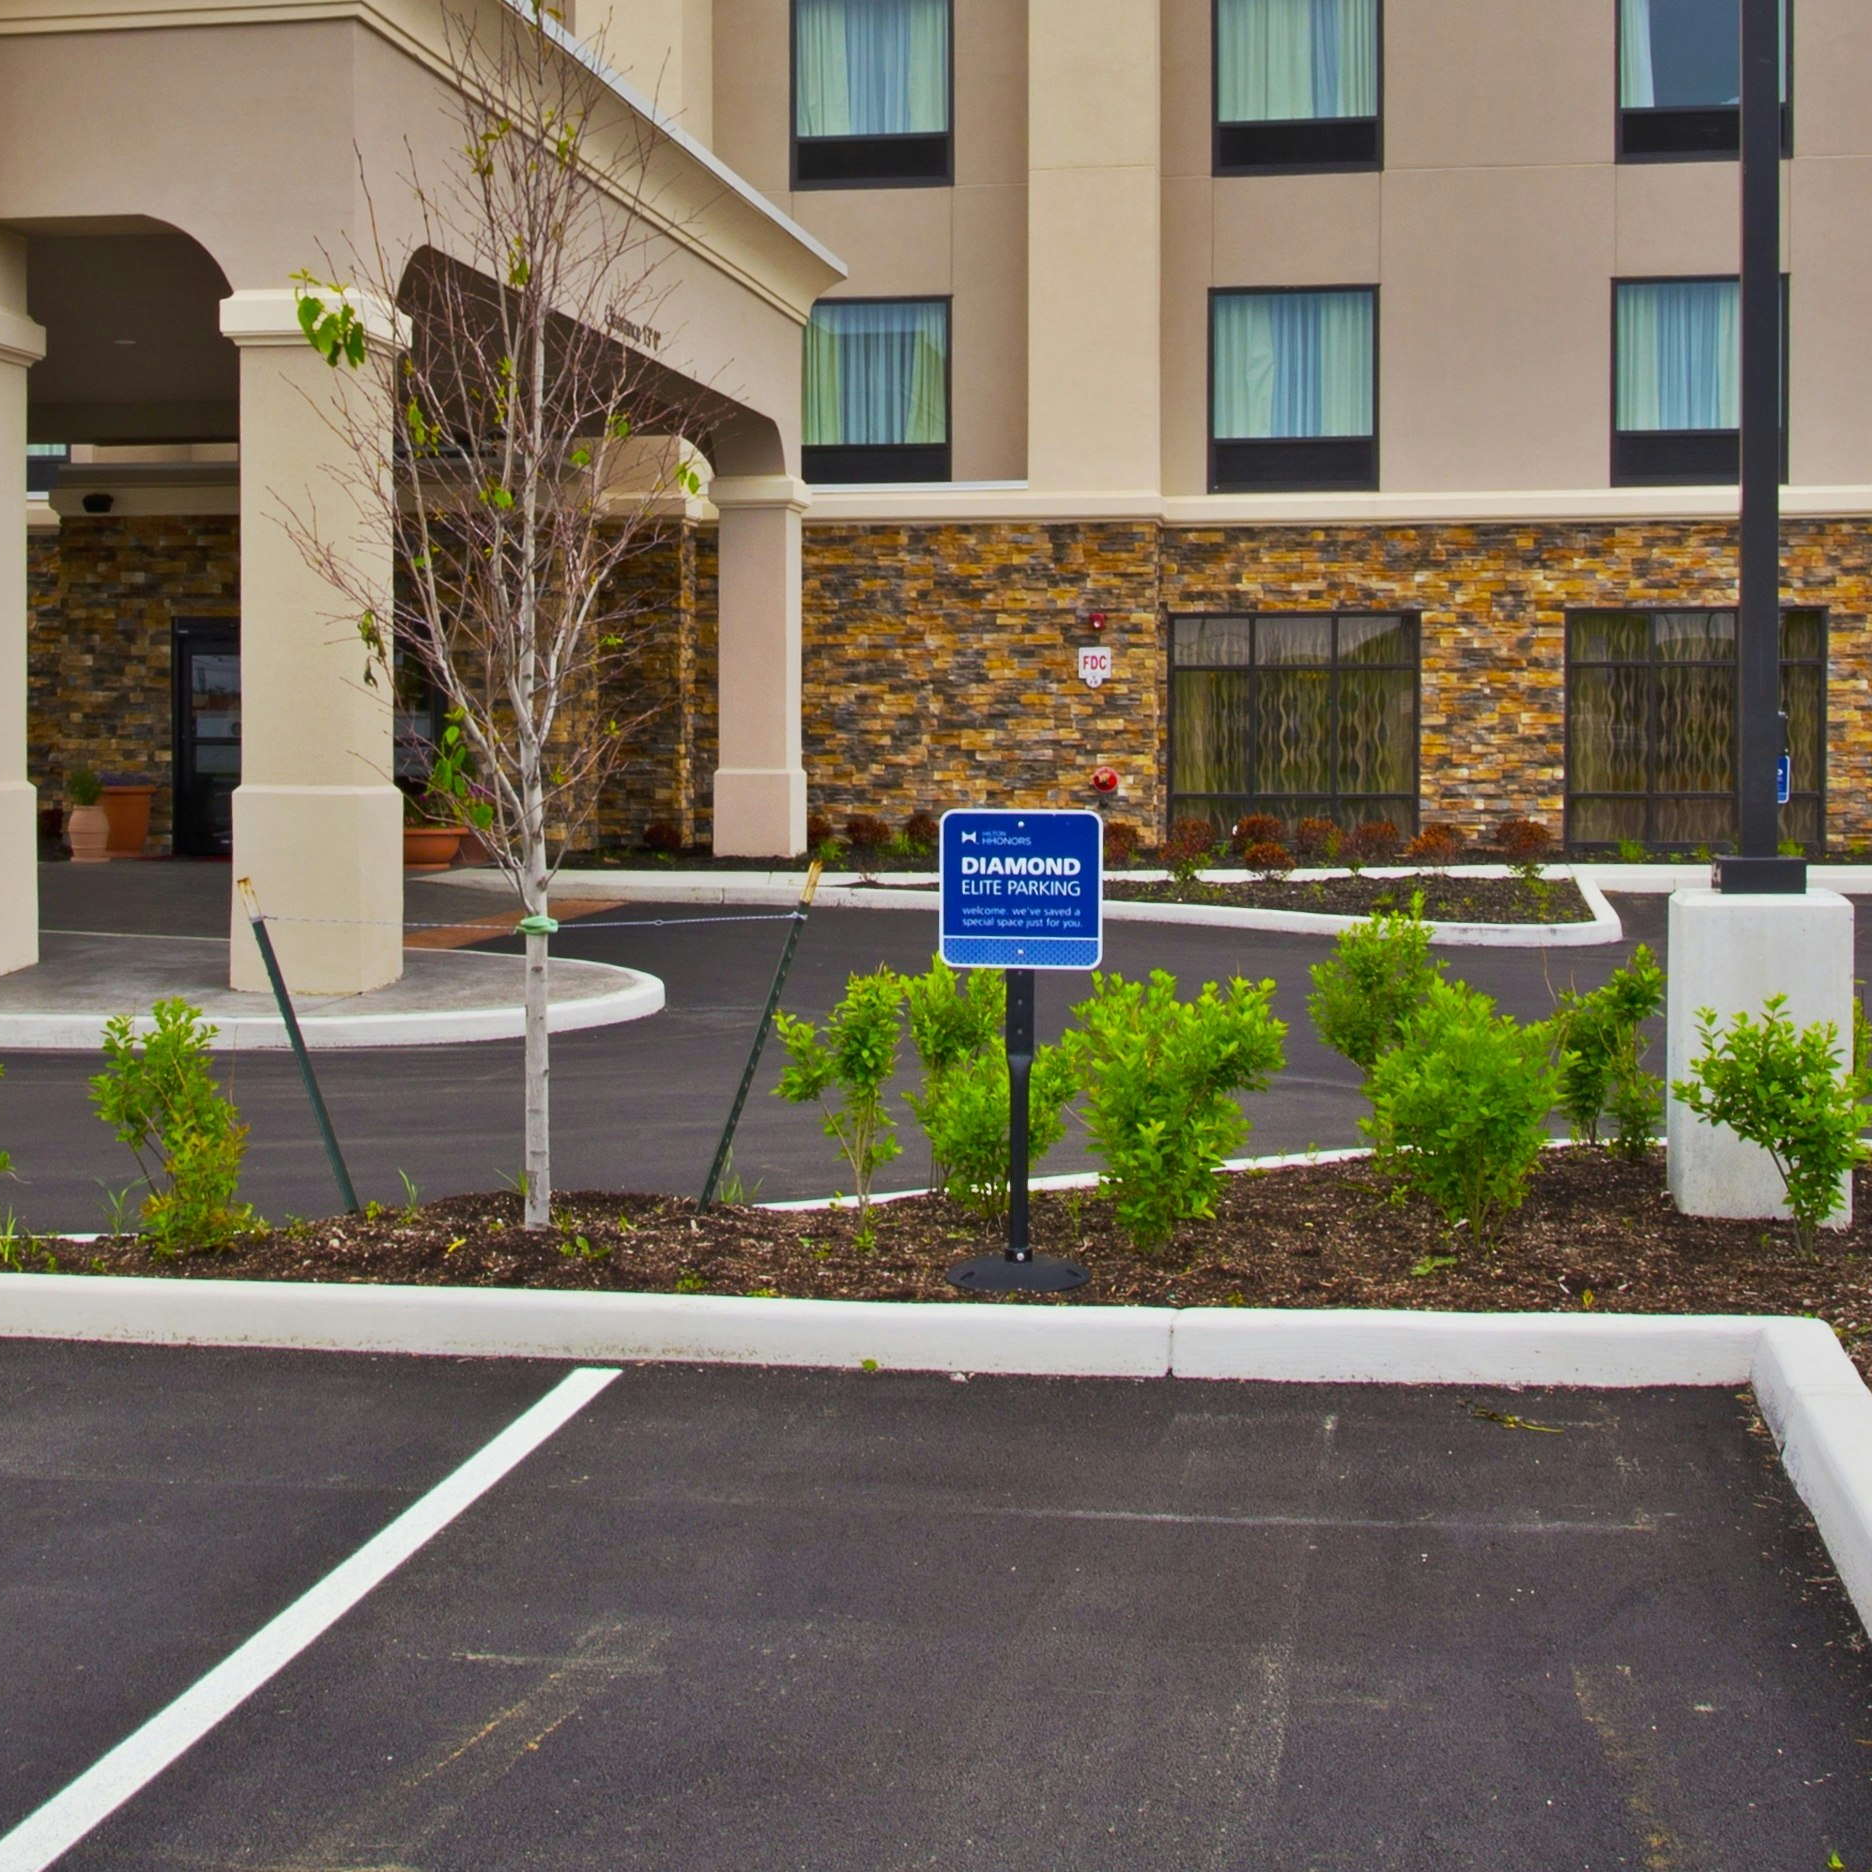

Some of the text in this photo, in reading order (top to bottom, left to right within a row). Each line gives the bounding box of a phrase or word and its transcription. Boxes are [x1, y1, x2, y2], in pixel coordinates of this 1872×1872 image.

[1083, 655, 1107, 670] FDC
[961, 856, 1081, 876] DIAMOND
[962, 879, 1081, 897] ELITE PARKING
[1012, 907, 1041, 916] we've
[1044, 907, 1072, 916] saved
[1074, 908, 1081, 916] a
[962, 917, 995, 928] special
[997, 919, 1024, 928] space
[1025, 918, 1043, 929] just
[1046, 917, 1059, 928] for
